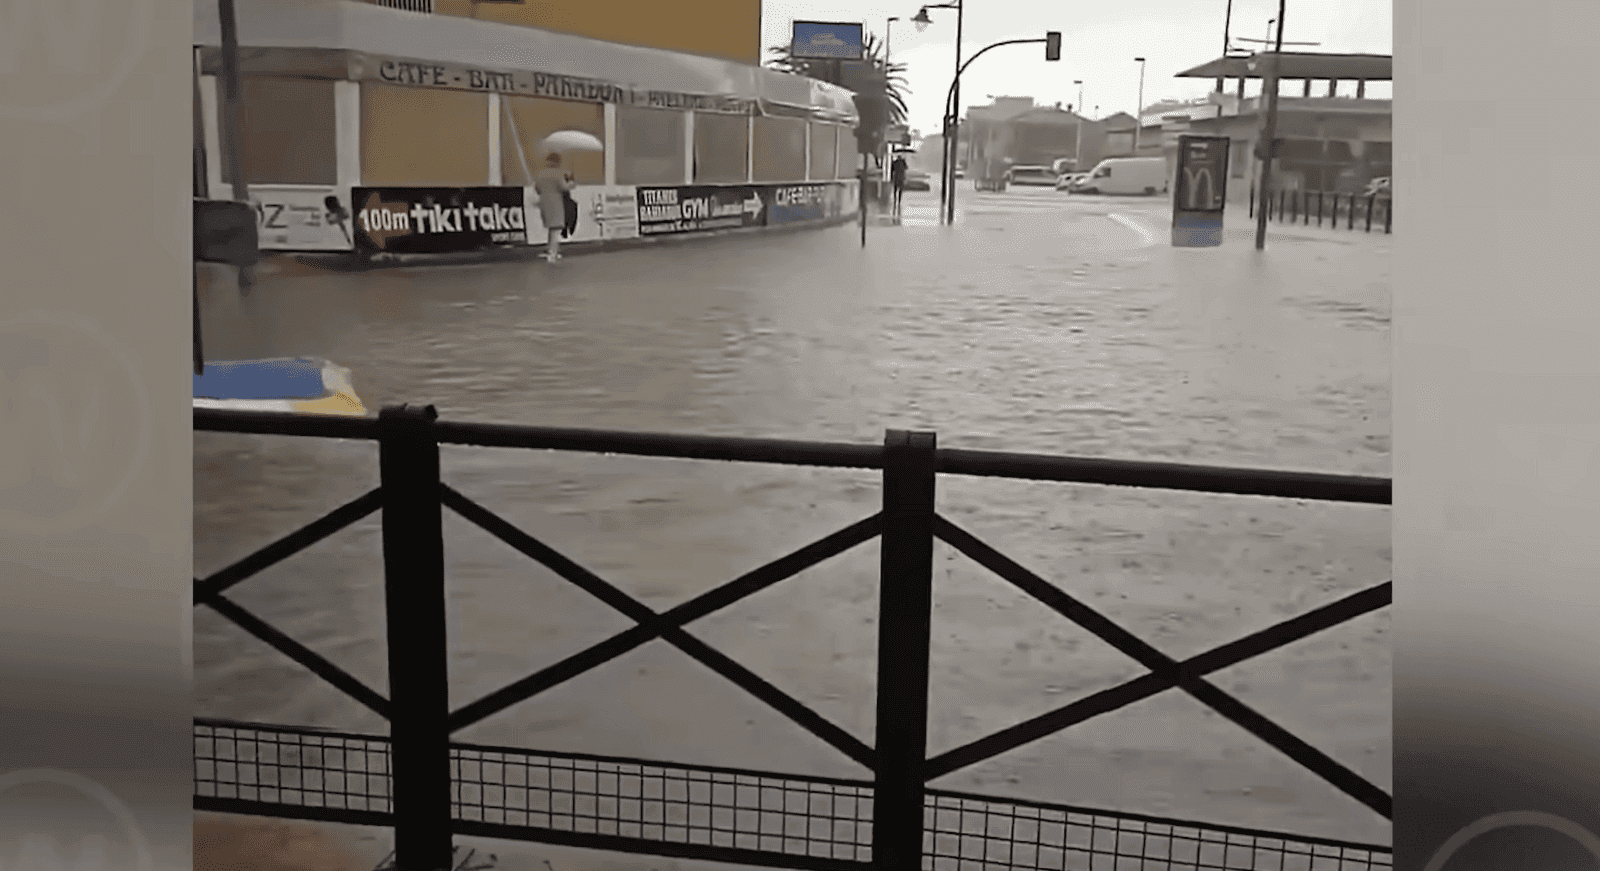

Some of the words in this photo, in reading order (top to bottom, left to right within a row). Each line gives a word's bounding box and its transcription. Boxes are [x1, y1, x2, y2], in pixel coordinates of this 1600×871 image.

[380, 60, 448, 86] CAFE
[466, 69, 515, 91] BAR
[358, 208, 410, 233] 100m
[410, 199, 464, 234] tiki
[463, 201, 525, 232] taka
[682, 197, 709, 219] GYM
